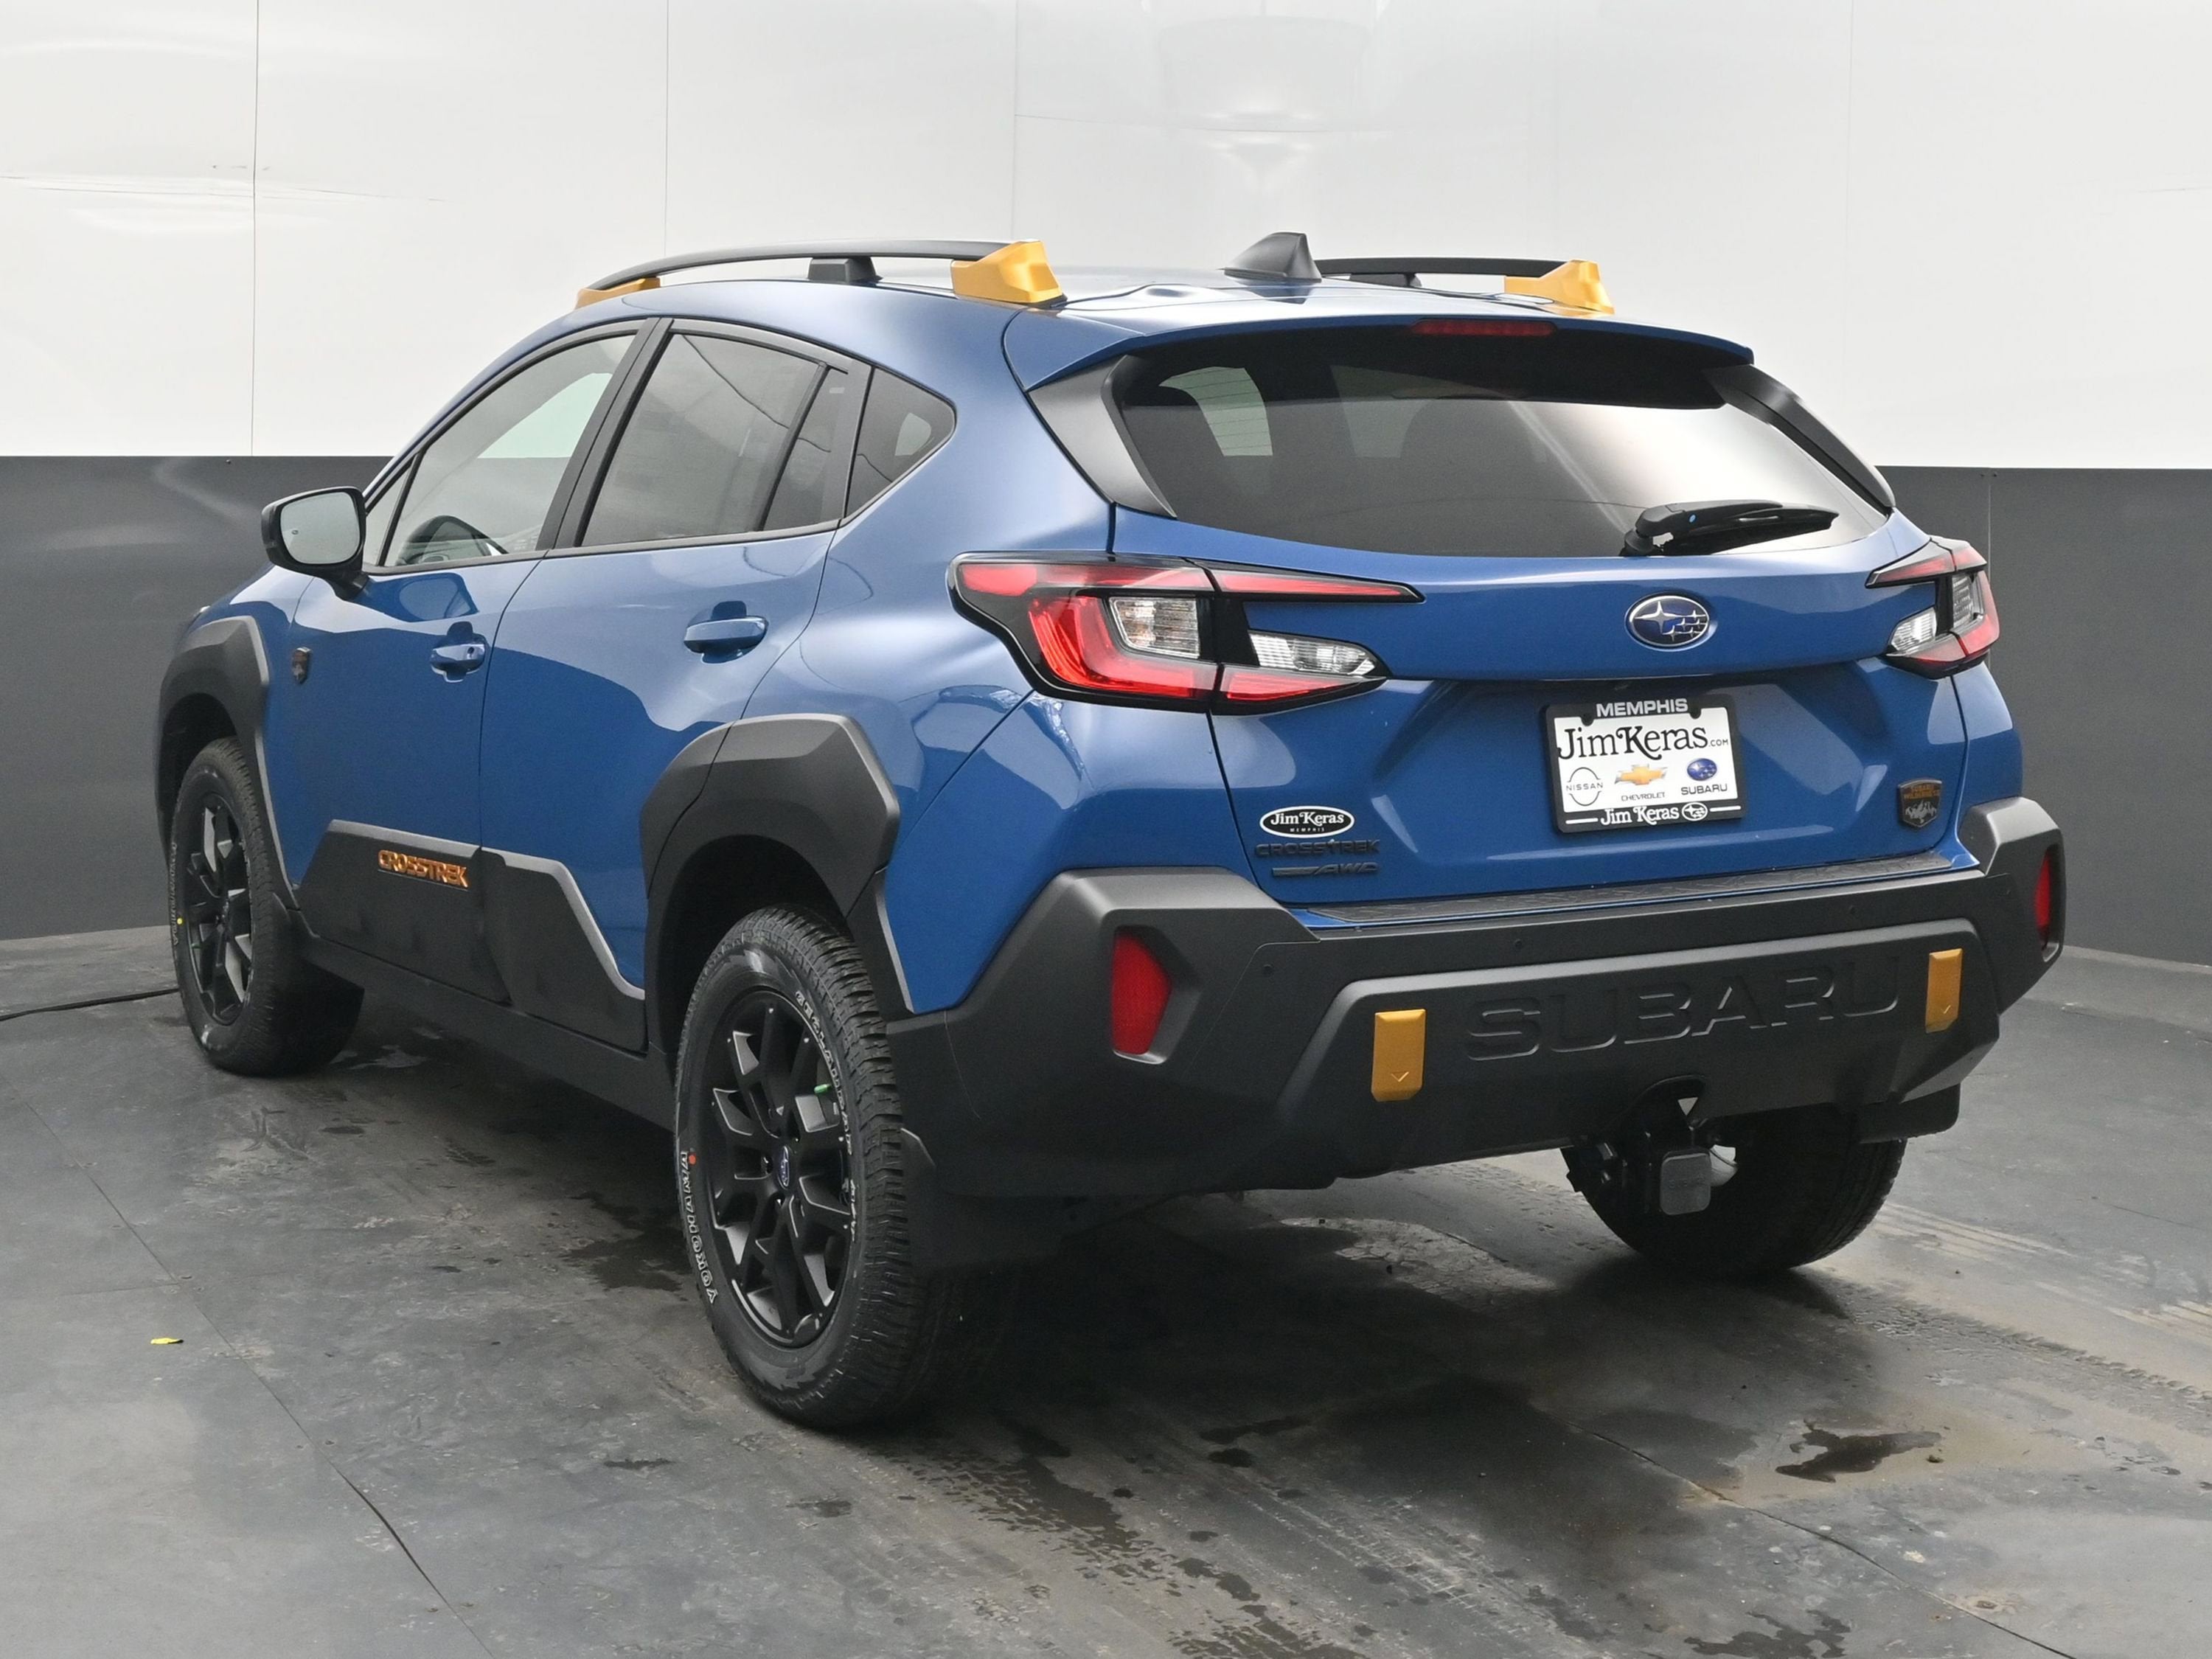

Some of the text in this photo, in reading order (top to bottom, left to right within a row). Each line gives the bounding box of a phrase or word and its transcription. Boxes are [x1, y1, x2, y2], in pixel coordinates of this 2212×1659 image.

[1596, 698, 1688, 717] MEMPHIS
[1566, 782, 1604, 792] NISSAN
[1681, 784, 1728, 795] SUBARU
[1621, 792, 1666, 801] CHEVROLET
[1600, 805, 1680, 826] Jim Keras
[1256, 839, 1380, 856] CROSSTREK
[378, 849, 468, 888] CROSSTREK
[1314, 861, 1379, 876] AWD
[1467, 957, 1899, 1061] SUBARU
[681, 1150, 718, 1304] YOKOHAMA
